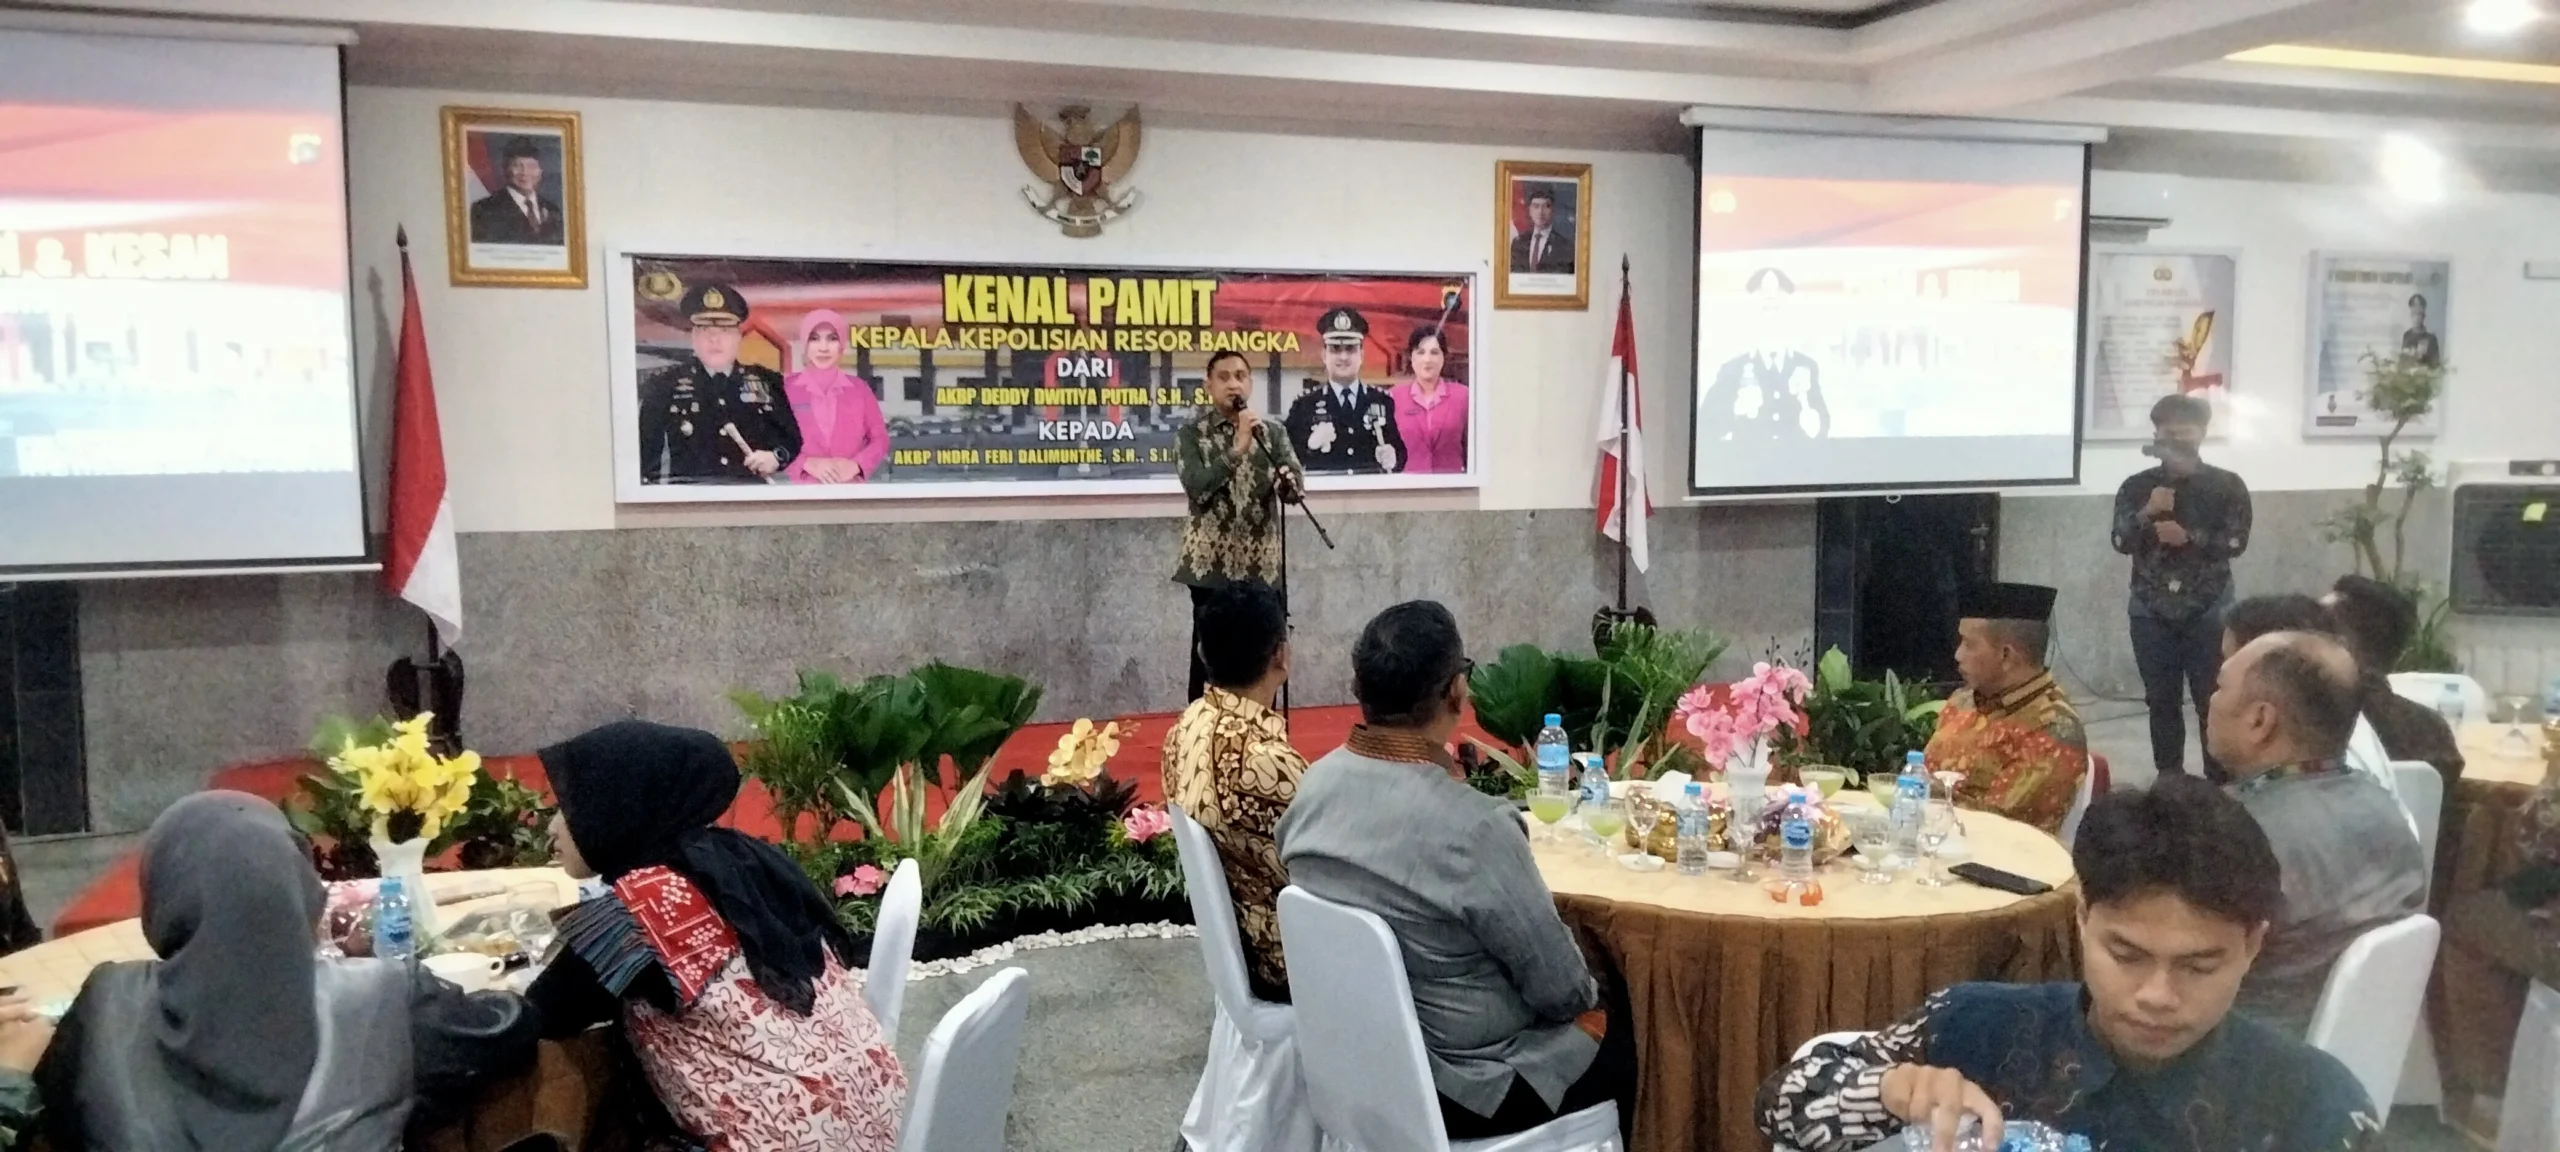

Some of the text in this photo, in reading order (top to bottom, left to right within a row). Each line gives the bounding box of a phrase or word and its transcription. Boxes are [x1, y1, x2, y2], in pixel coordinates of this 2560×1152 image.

[36, 239, 72, 277] &
[85, 232, 228, 279] KESAN
[944, 275, 1217, 325] KENAL PAMIT
[850, 326, 1299, 352] KEPALA KEPOLISIAN RESOR BANGKA
[1058, 357, 1112, 377] DARI
[936, 388, 976, 405] AKBP
[981, 388, 1029, 405] DEDDY
[1034, 388, 1098, 405] DWITIYA
[1101, 388, 1153, 406] PUTRA,
[1039, 421, 1134, 440] KEPADA
[894, 449, 931, 464] AKBP
[936, 449, 980, 464] INDRA
[985, 449, 1013, 464] FERI
[1018, 449, 1107, 465] DALIMUNTHE,
